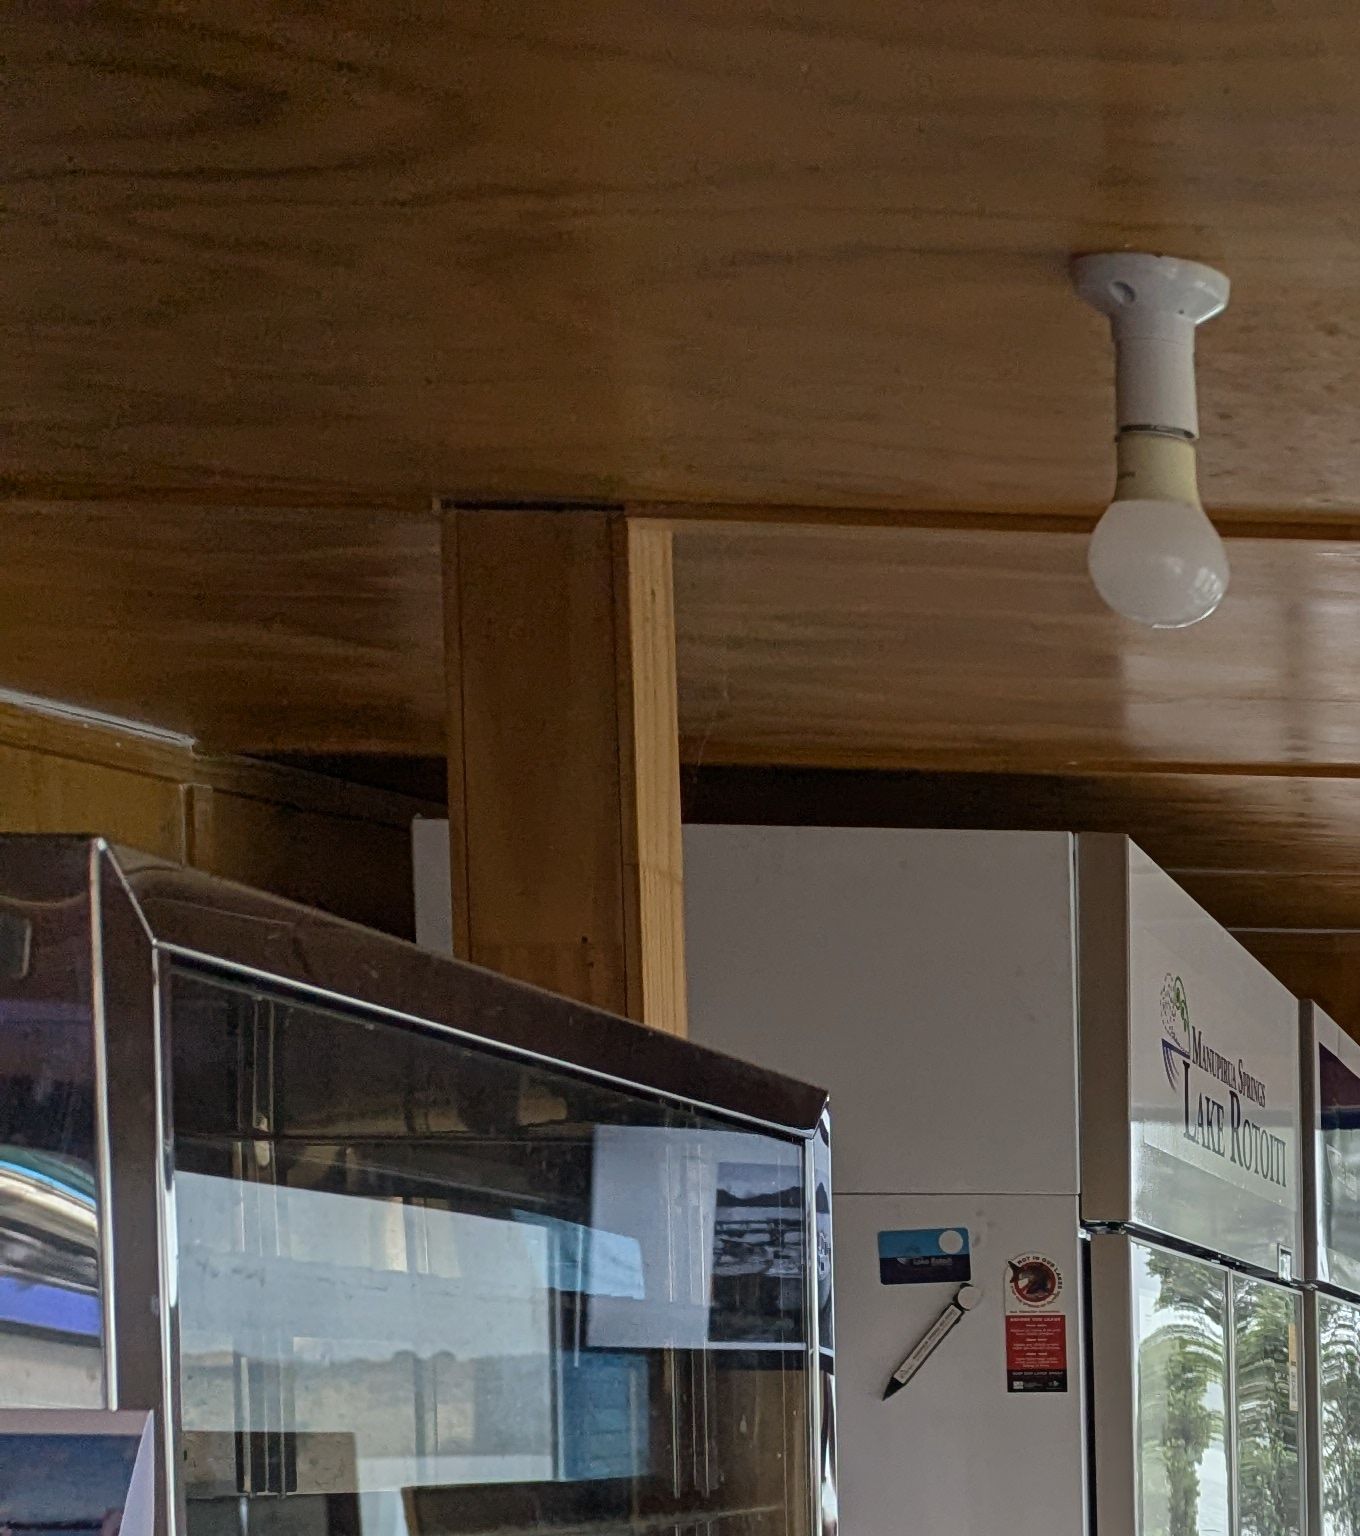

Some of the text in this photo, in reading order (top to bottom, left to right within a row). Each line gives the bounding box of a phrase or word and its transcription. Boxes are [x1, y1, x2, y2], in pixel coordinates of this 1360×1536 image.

[1182, 1060, 1226, 1157] LAKE
[1229, 1089, 1287, 1187] ROTOITI
[1238, 1059, 1266, 1108] SPRINGS
